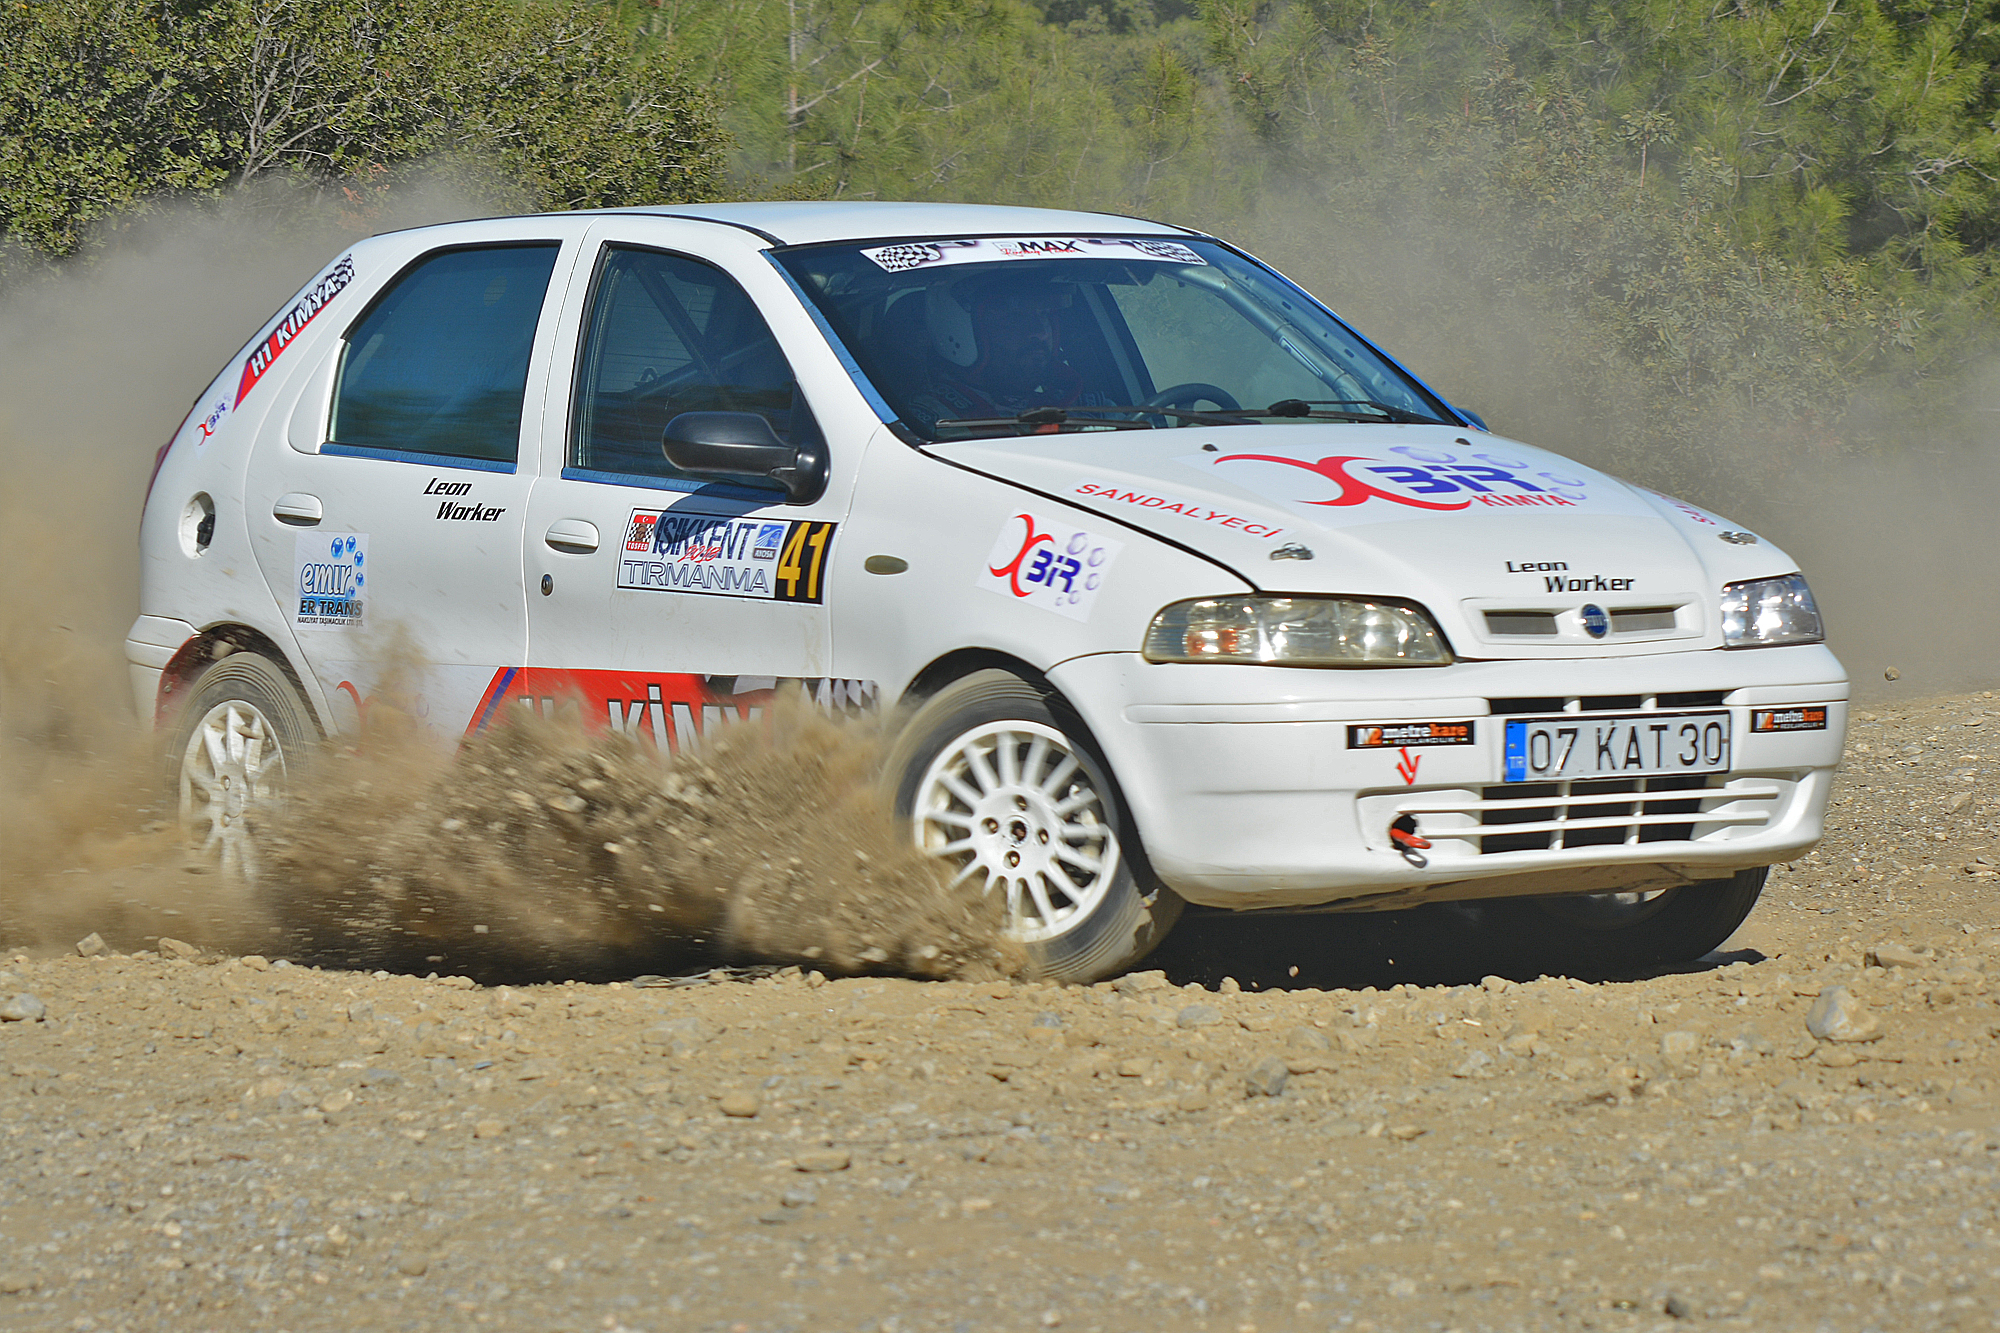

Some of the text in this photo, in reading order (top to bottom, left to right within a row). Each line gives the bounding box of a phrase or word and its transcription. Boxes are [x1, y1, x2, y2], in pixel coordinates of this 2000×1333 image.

[251, 278, 337, 378] H1 KİMYA
[423, 477, 473, 496] Leon
[1471, 493, 1576, 508] KİMYA
[436, 501, 506, 522] Worker
[1076, 484, 1284, 538] SANDALYECİ
[627, 542, 648, 551] TOSFED
[778, 522, 832, 598] 41
[1505, 560, 1568, 574] Leon
[624, 560, 769, 593] TIRMANMA
[1544, 575, 1635, 593] Worker
[299, 599, 364, 618] ER TRANS
[1382, 723, 1468, 738] metrekare
[1530, 727, 1578, 775] 07
[1599, 724, 1668, 771] KAT
[1679, 722, 1721, 766] 30
